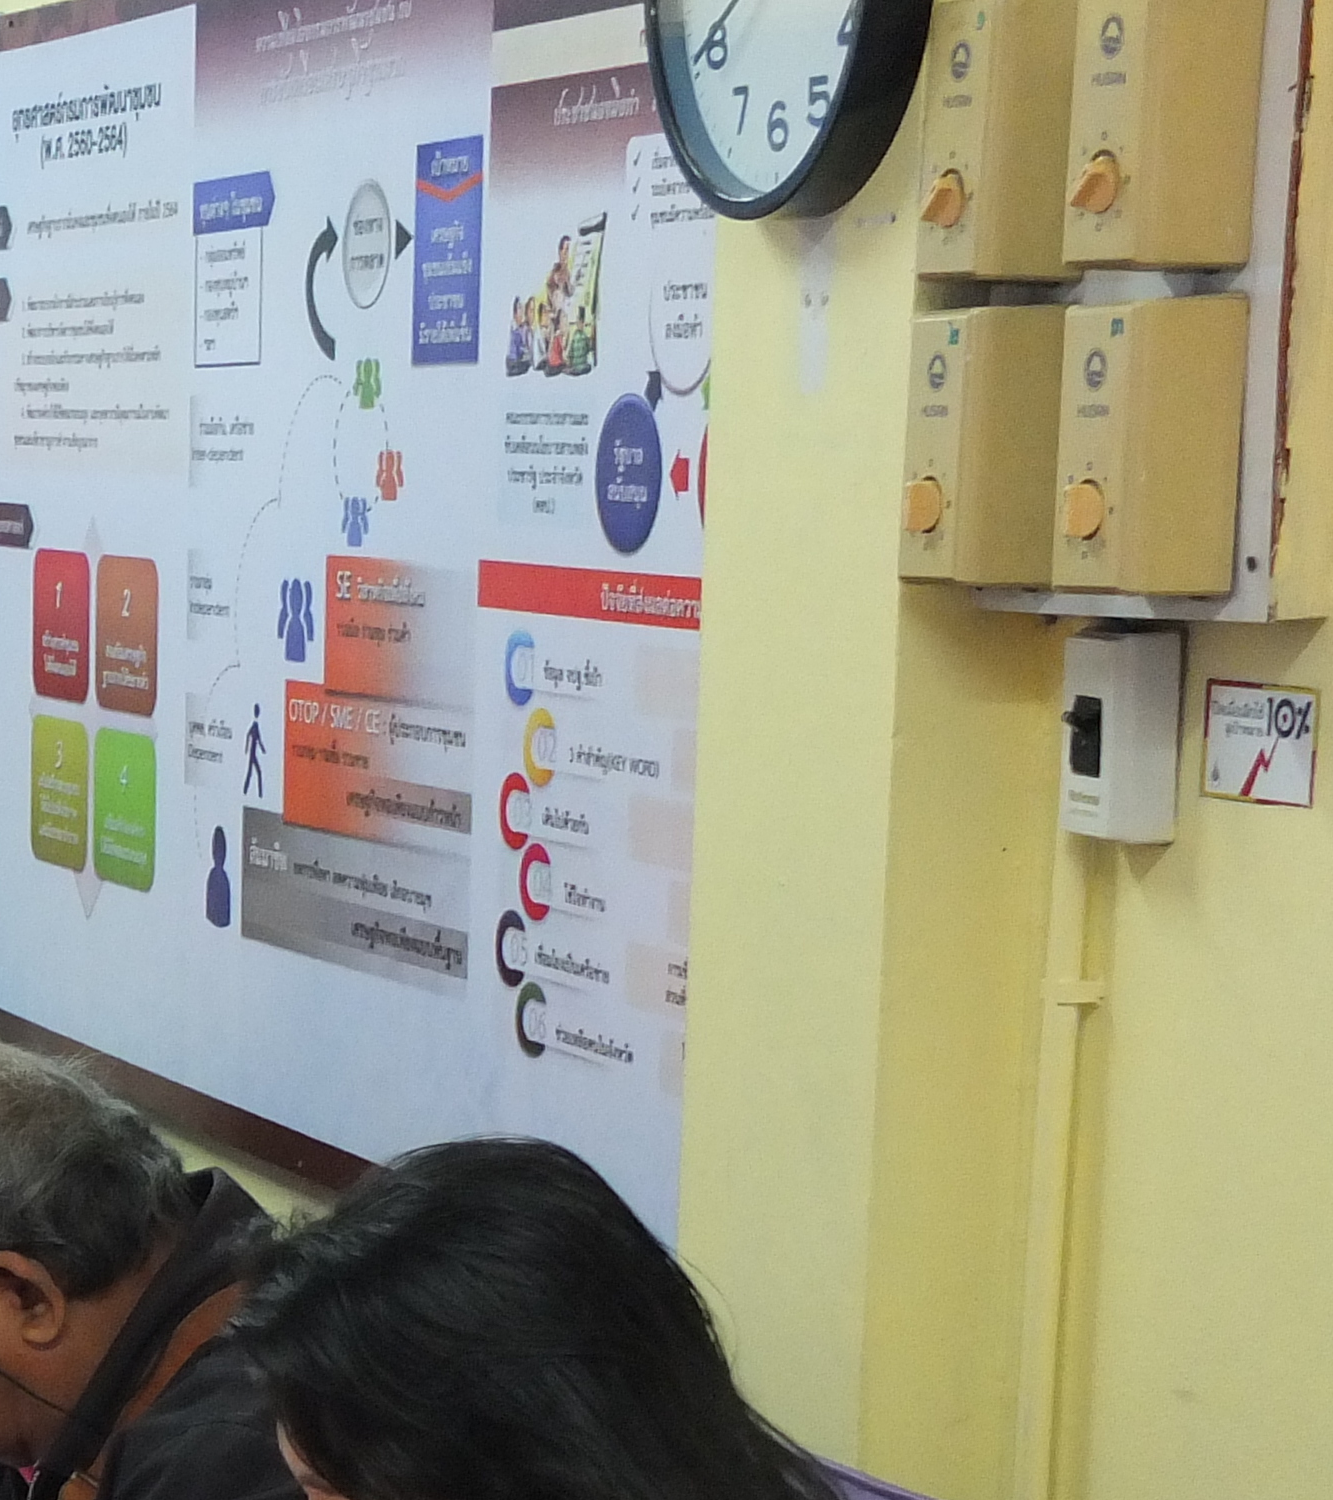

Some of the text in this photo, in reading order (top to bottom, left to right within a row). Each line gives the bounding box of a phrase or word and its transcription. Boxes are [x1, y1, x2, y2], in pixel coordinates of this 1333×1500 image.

[733, 85, 749, 136] 7
[807, 75, 831, 128] 5
[767, 100, 789, 152] 6
[54, 580, 64, 609] 1
[335, 569, 353, 599] SE
[121, 587, 131, 618] 2
[288, 698, 319, 724] OTOP
[329, 703, 353, 731] SME
[1266, 696, 1313, 740] 10%
[54, 740, 64, 769] 3
[119, 764, 129, 794] 4
